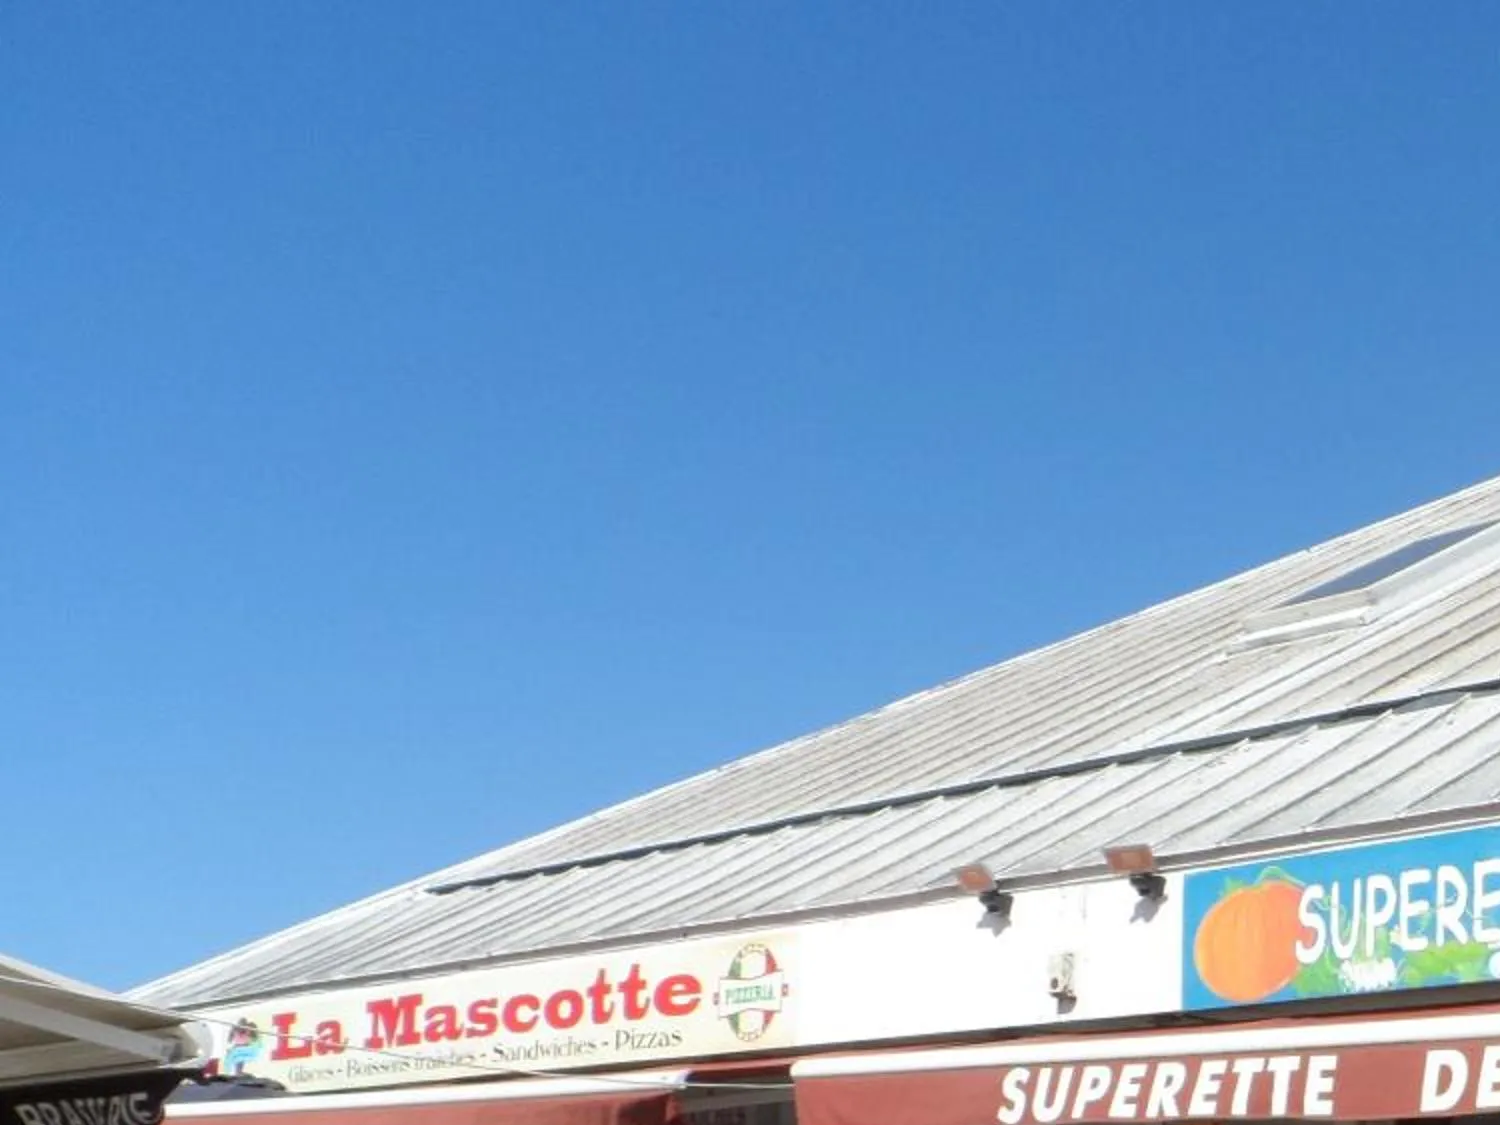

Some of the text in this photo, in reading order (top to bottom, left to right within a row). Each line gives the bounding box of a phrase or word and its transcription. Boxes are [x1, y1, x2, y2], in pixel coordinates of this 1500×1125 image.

[271, 964, 701, 1060] La Mascotte
[491, 1036, 598, 1063] Sandwiches
[614, 1027, 684, 1052] Pizzas
[997, 1055, 1339, 1125] SUPERETTE
